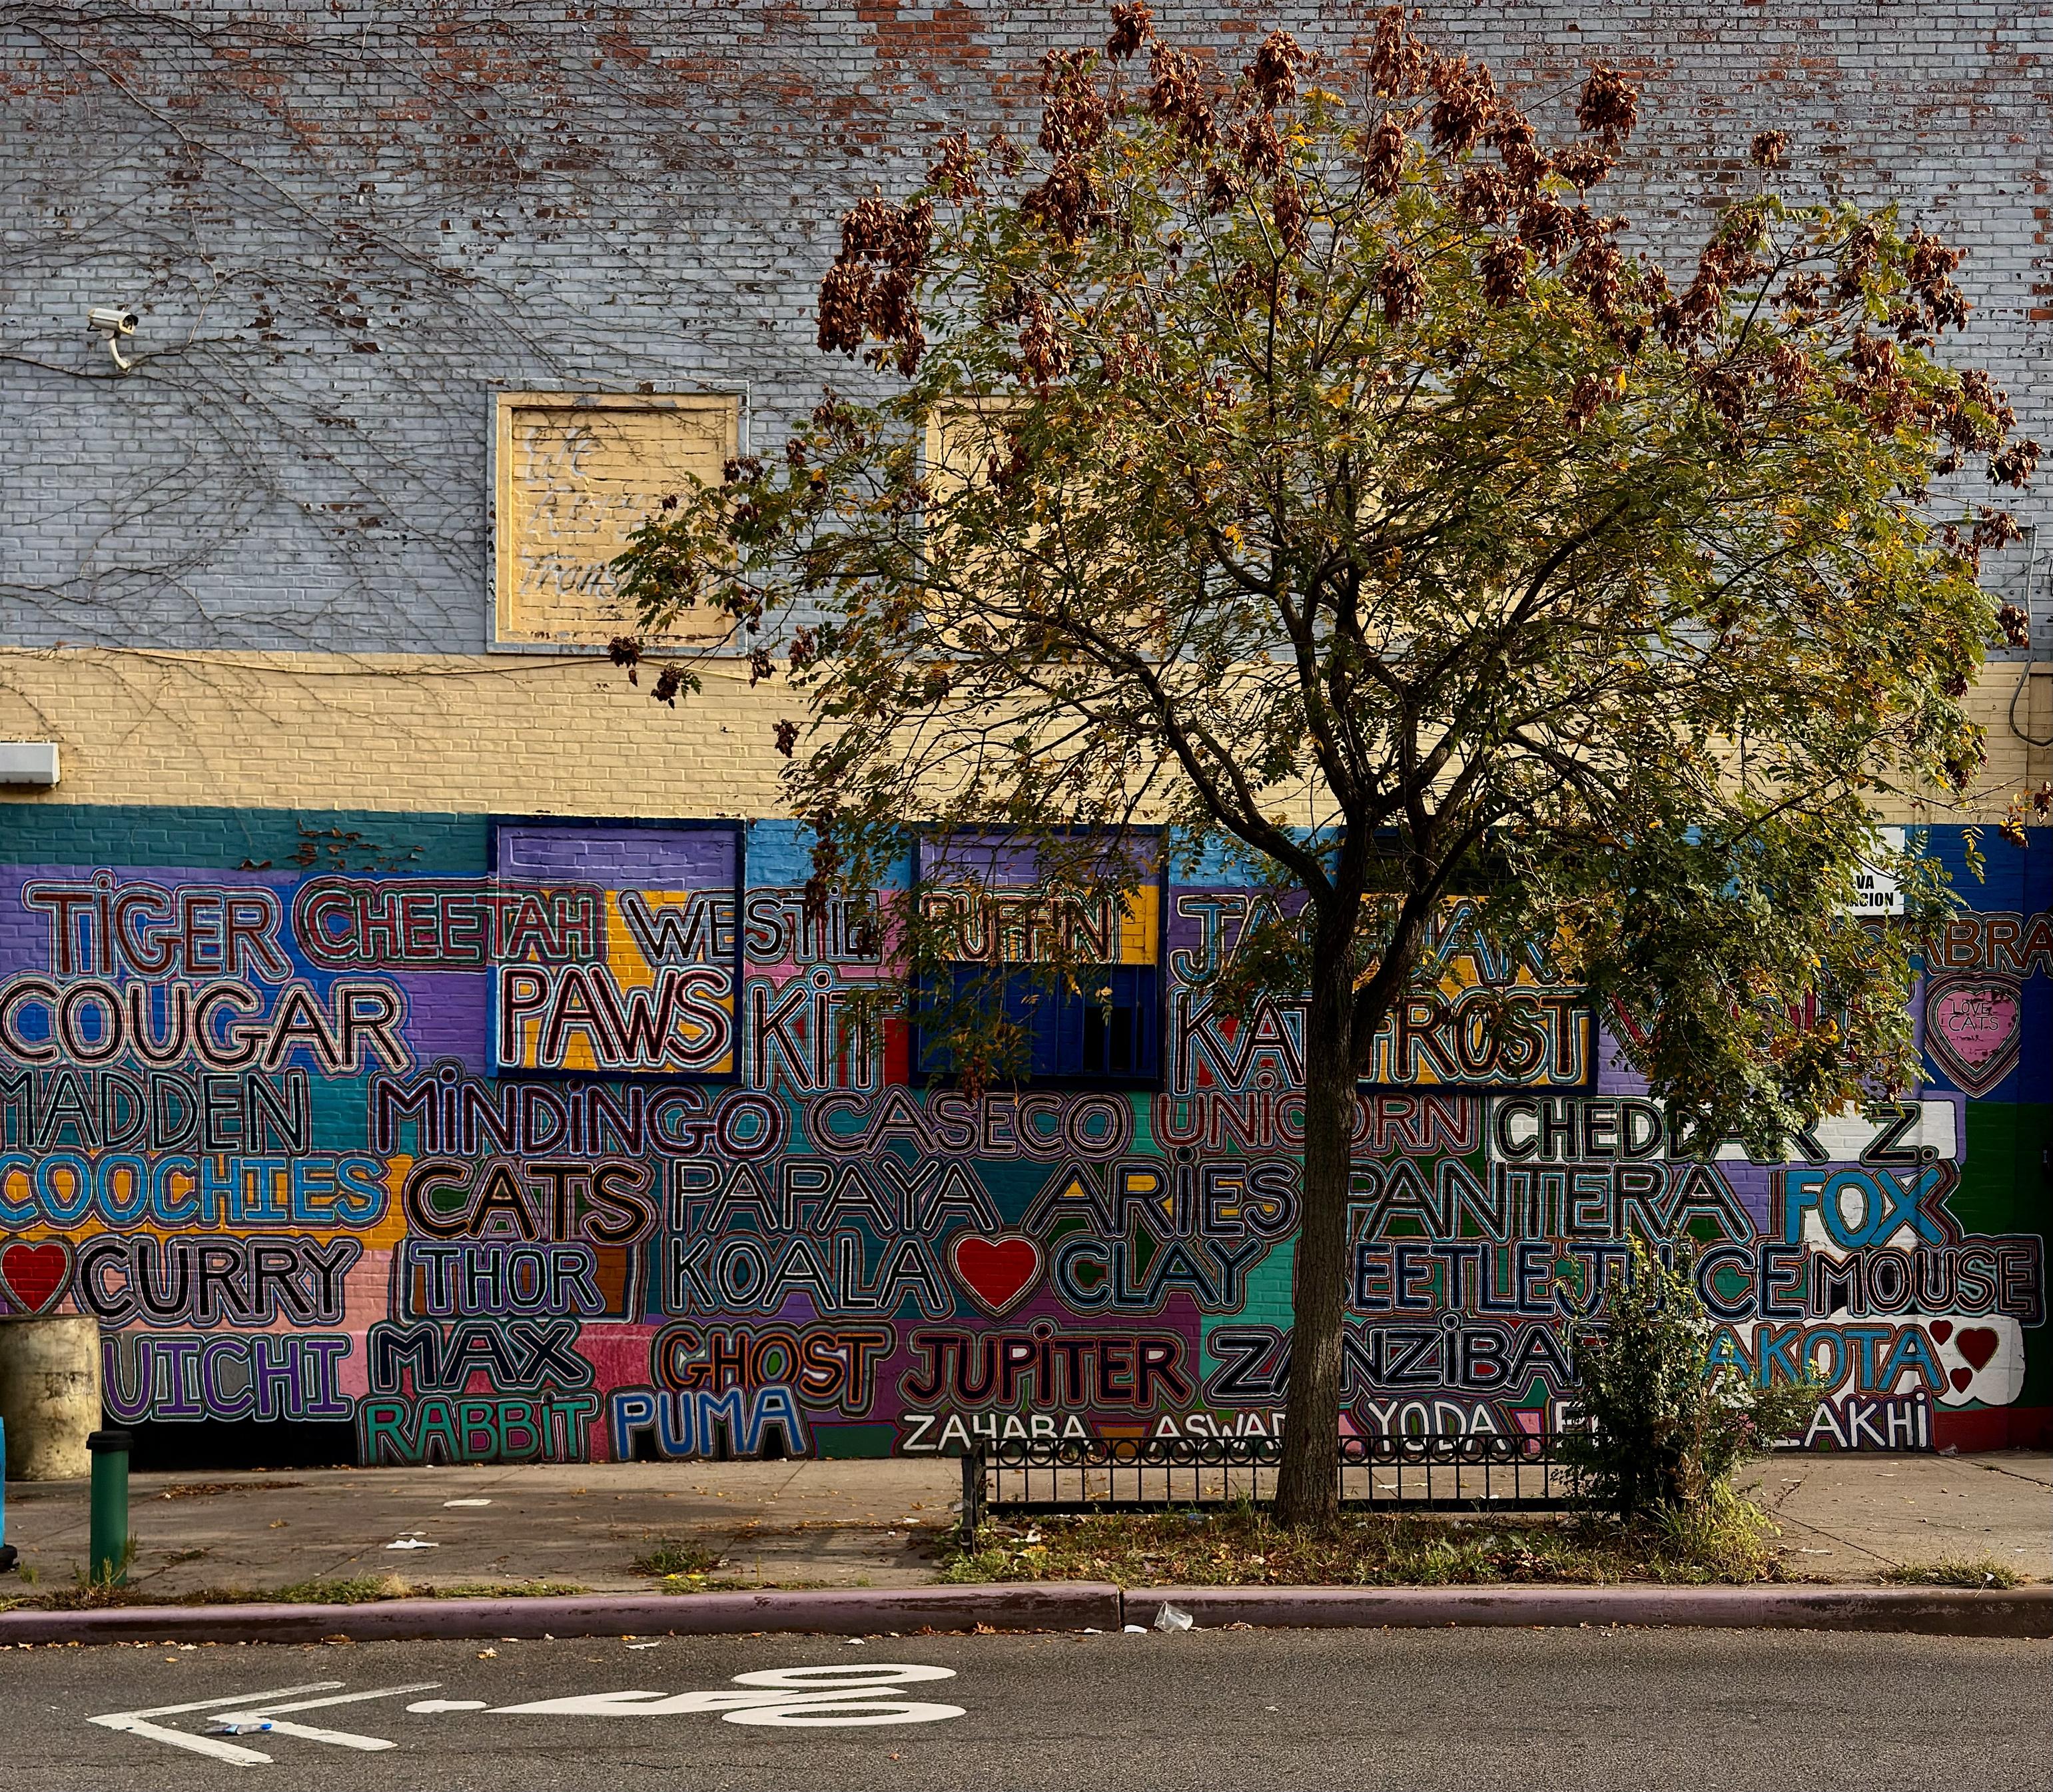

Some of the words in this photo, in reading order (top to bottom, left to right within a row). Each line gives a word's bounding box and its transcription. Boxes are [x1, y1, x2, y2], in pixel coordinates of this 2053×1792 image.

[28, 871, 292, 977] TiGER
[298, 882, 600, 967] CHEETAH
[0, 978, 412, 1069] COUGAR
[501, 965, 734, 1067] PAWS
[1356, 989, 1588, 1083] ROST
[1948, 1016, 1999, 1032] CATS
[1951, 1000, 1990, 1016] LOVE
[0, 1067, 309, 1154] MADDEN
[372, 1065, 787, 1156] MiNDiNGO
[803, 1087, 1130, 1156] CASECO
[0, 1152, 388, 1226] COOCHIES
[404, 1158, 659, 1244] CATS
[669, 1159, 1003, 1234] PAPAYA
[1022, 1146, 1302, 1239] ARiES
[1783, 1168, 1950, 1250] FOX
[75, 1238, 360, 1322] CURRY
[412, 1244, 604, 1311] THOR
[667, 1234, 949, 1311] KOALA
[1052, 1234, 1266, 1311] CLAY
[1808, 1246, 2038, 1316] MOUSE
[372, 1323, 590, 1392] MAX
[655, 1324, 890, 1409] GHOST
[901, 1322, 1194, 1407] JUPiTER
[1681, 1326, 1944, 1394] AKOTA
[610, 1386, 810, 1460] PUMA
[902, 1414, 1095, 1451] ZAHABA
[1368, 1400, 1507, 1452] YODA
